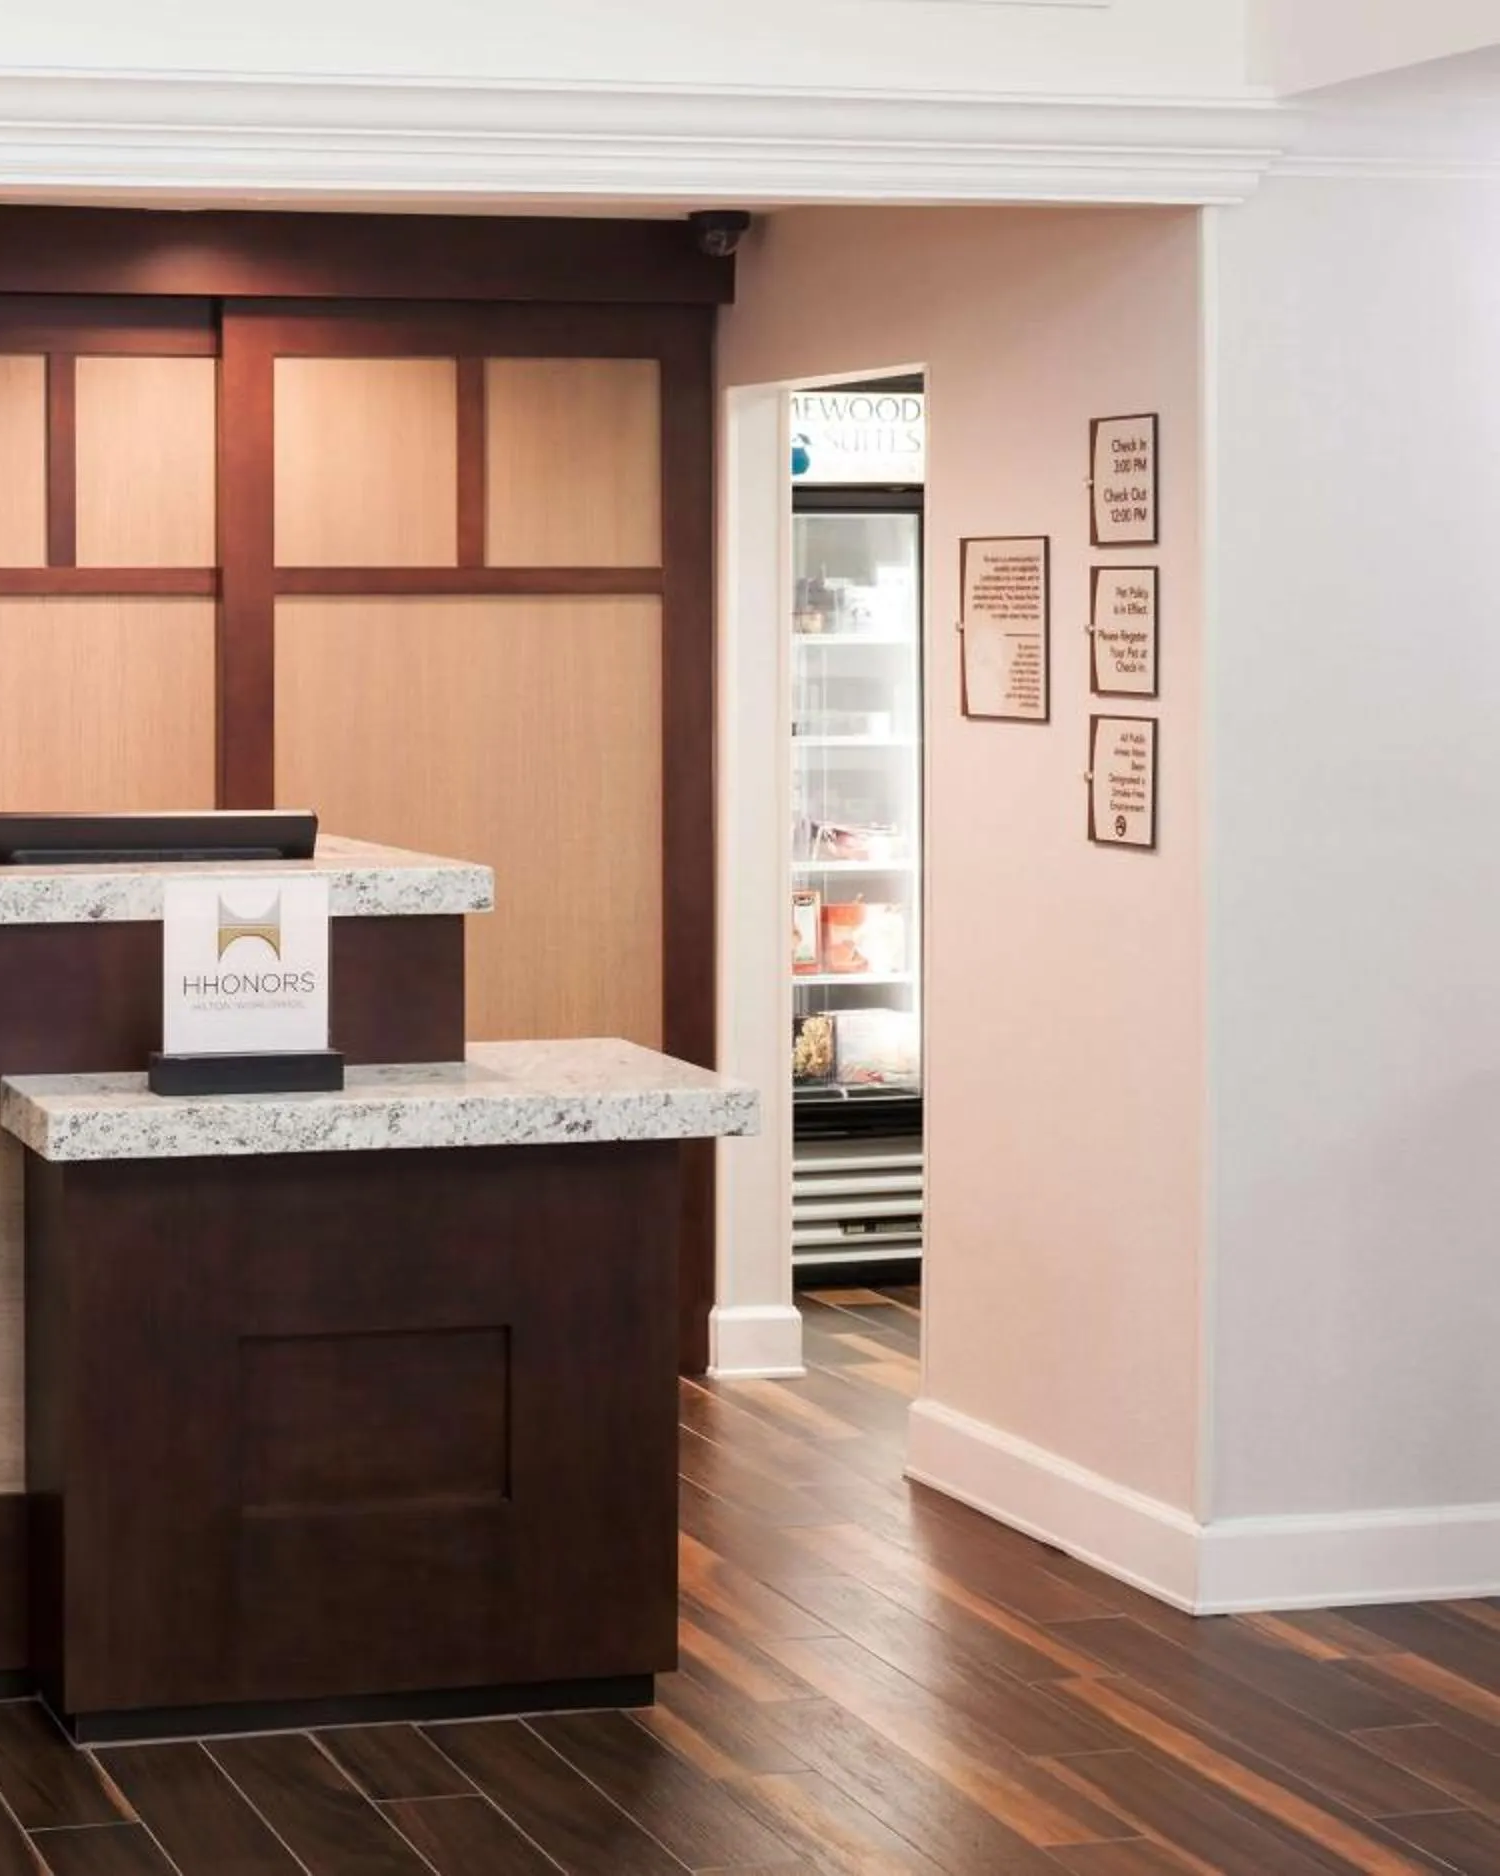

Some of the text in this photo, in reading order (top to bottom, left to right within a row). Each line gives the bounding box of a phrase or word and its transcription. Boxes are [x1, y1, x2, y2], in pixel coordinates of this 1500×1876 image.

[1112, 438, 1137, 452] Check
[1134, 457, 1147, 472] PM
[1104, 487, 1147, 502] Check Out
[1111, 507, 1147, 522] 12:00 PM
[1129, 586, 1148, 600] Policy
[1098, 629, 1148, 643] Please Register
[1128, 646, 1138, 658] Pet
[183, 971, 315, 996] HHONORS
